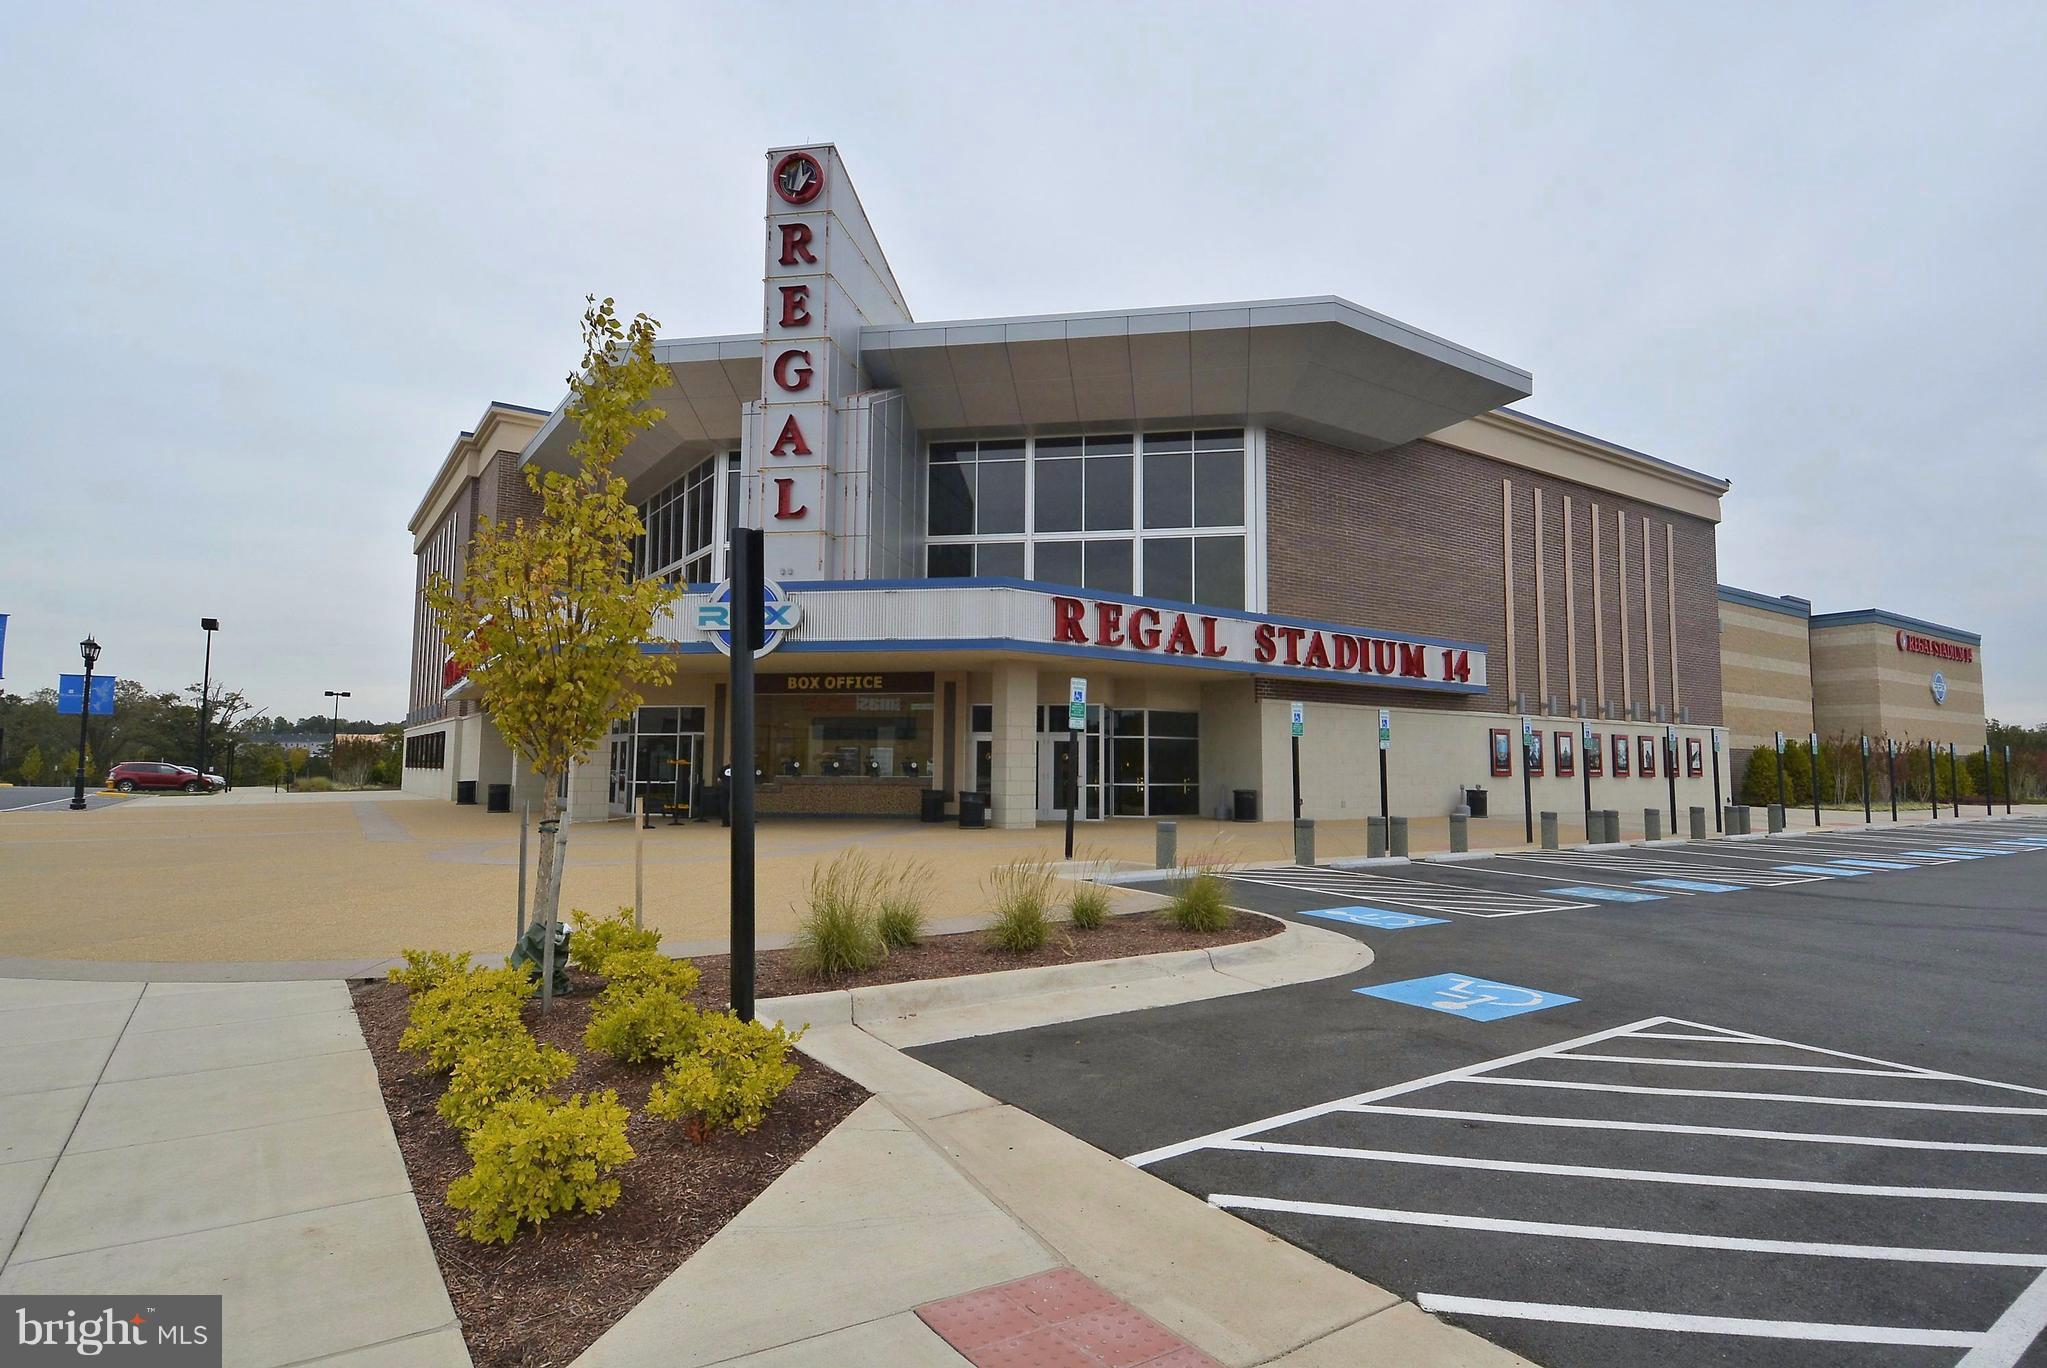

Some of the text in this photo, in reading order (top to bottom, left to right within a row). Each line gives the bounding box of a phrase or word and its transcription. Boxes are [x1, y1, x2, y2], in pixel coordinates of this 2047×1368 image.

[770, 222, 817, 521] REGAL
[698, 605, 792, 626] RX
[1052, 596, 1471, 683] REGAL STADIUM 14
[1907, 635, 1934, 655] REGAL
[787, 676, 883, 690] BOX OFFICE
